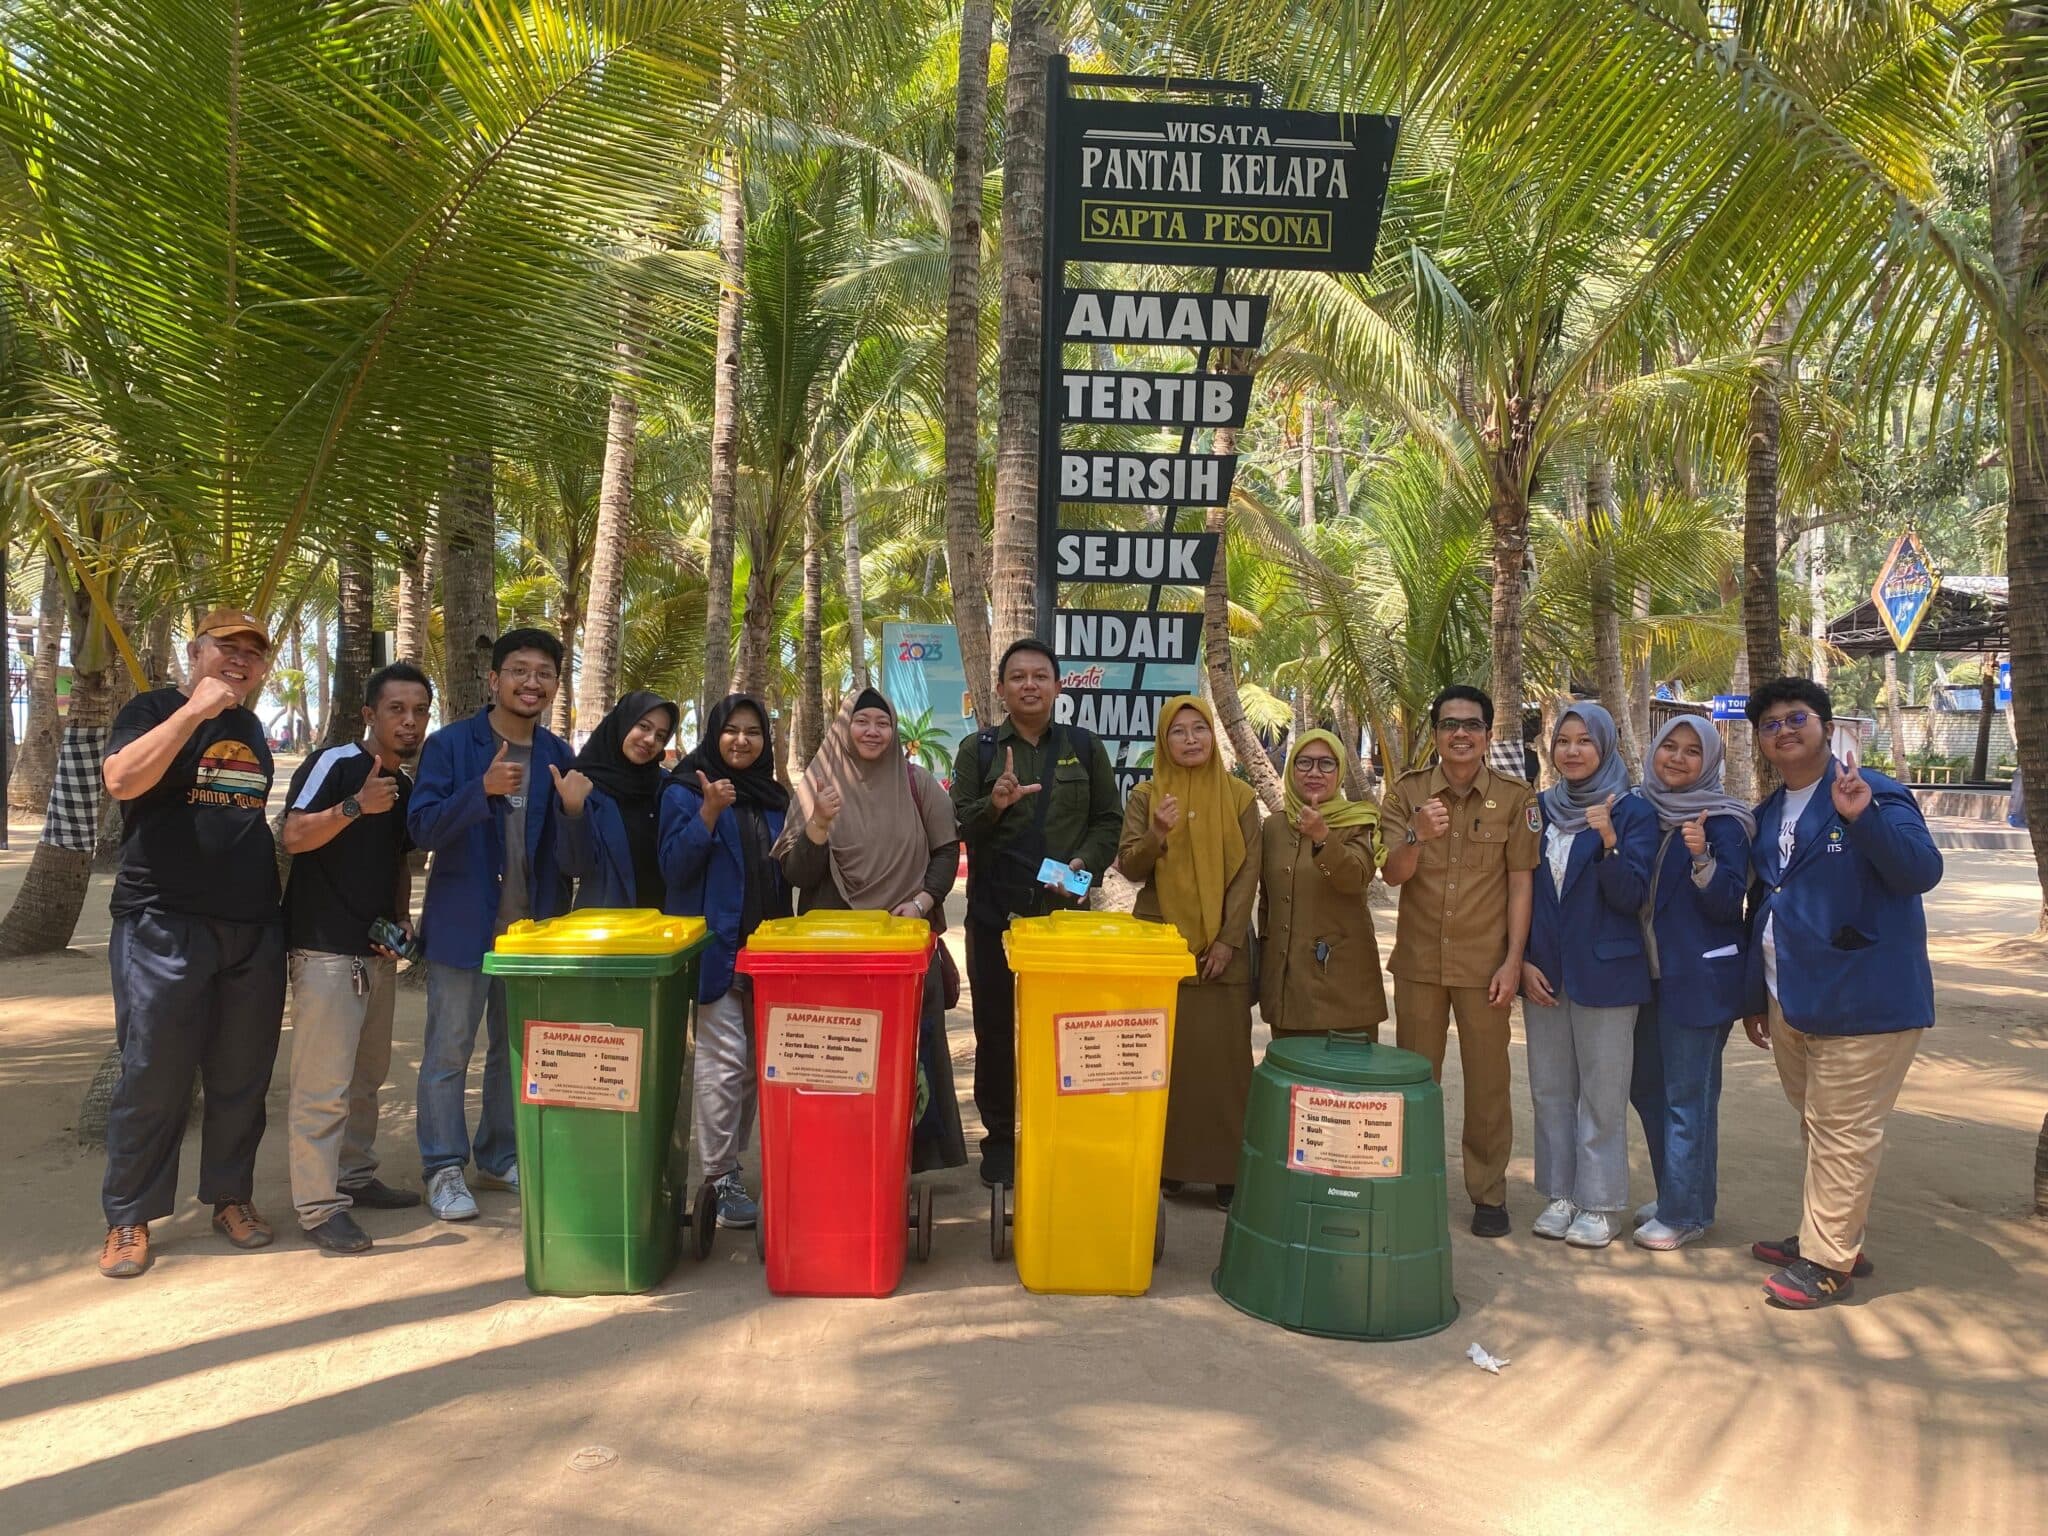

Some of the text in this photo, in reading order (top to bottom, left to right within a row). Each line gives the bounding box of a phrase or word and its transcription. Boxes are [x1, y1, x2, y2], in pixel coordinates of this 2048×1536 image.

[1166, 121, 1271, 147] WISATA
[1081, 147, 1349, 200] PANTAI KELAPA
[1091, 207, 1323, 245] SAPTA PESONA
[1065, 293, 1250, 343] AMAN
[1062, 375, 1234, 423] TERTIB
[1060, 455, 1219, 501] BERSIH
[1056, 534, 1201, 580] SEJUK
[1055, 613, 1184, 659] INDAH
[898, 641, 943, 662] 2023
[187, 788, 230, 804] PANTAI
[1827, 843, 1842, 853] ITS
[786, 1013, 862, 1026] SAMPAH KERTAS
[1065, 1017, 1159, 1031] SAMPAH ANORGANIK
[543, 1032, 625, 1046] SAMPAH ORGANIK
[540, 1072, 558, 1081] Sayur
[599, 1077, 624, 1085] Rumput
[1309, 1097, 1387, 1111] SAMPAH KOMPOS
[1306, 1138, 1324, 1147] Sayur
[1363, 1144, 1388, 1152] Rumput
